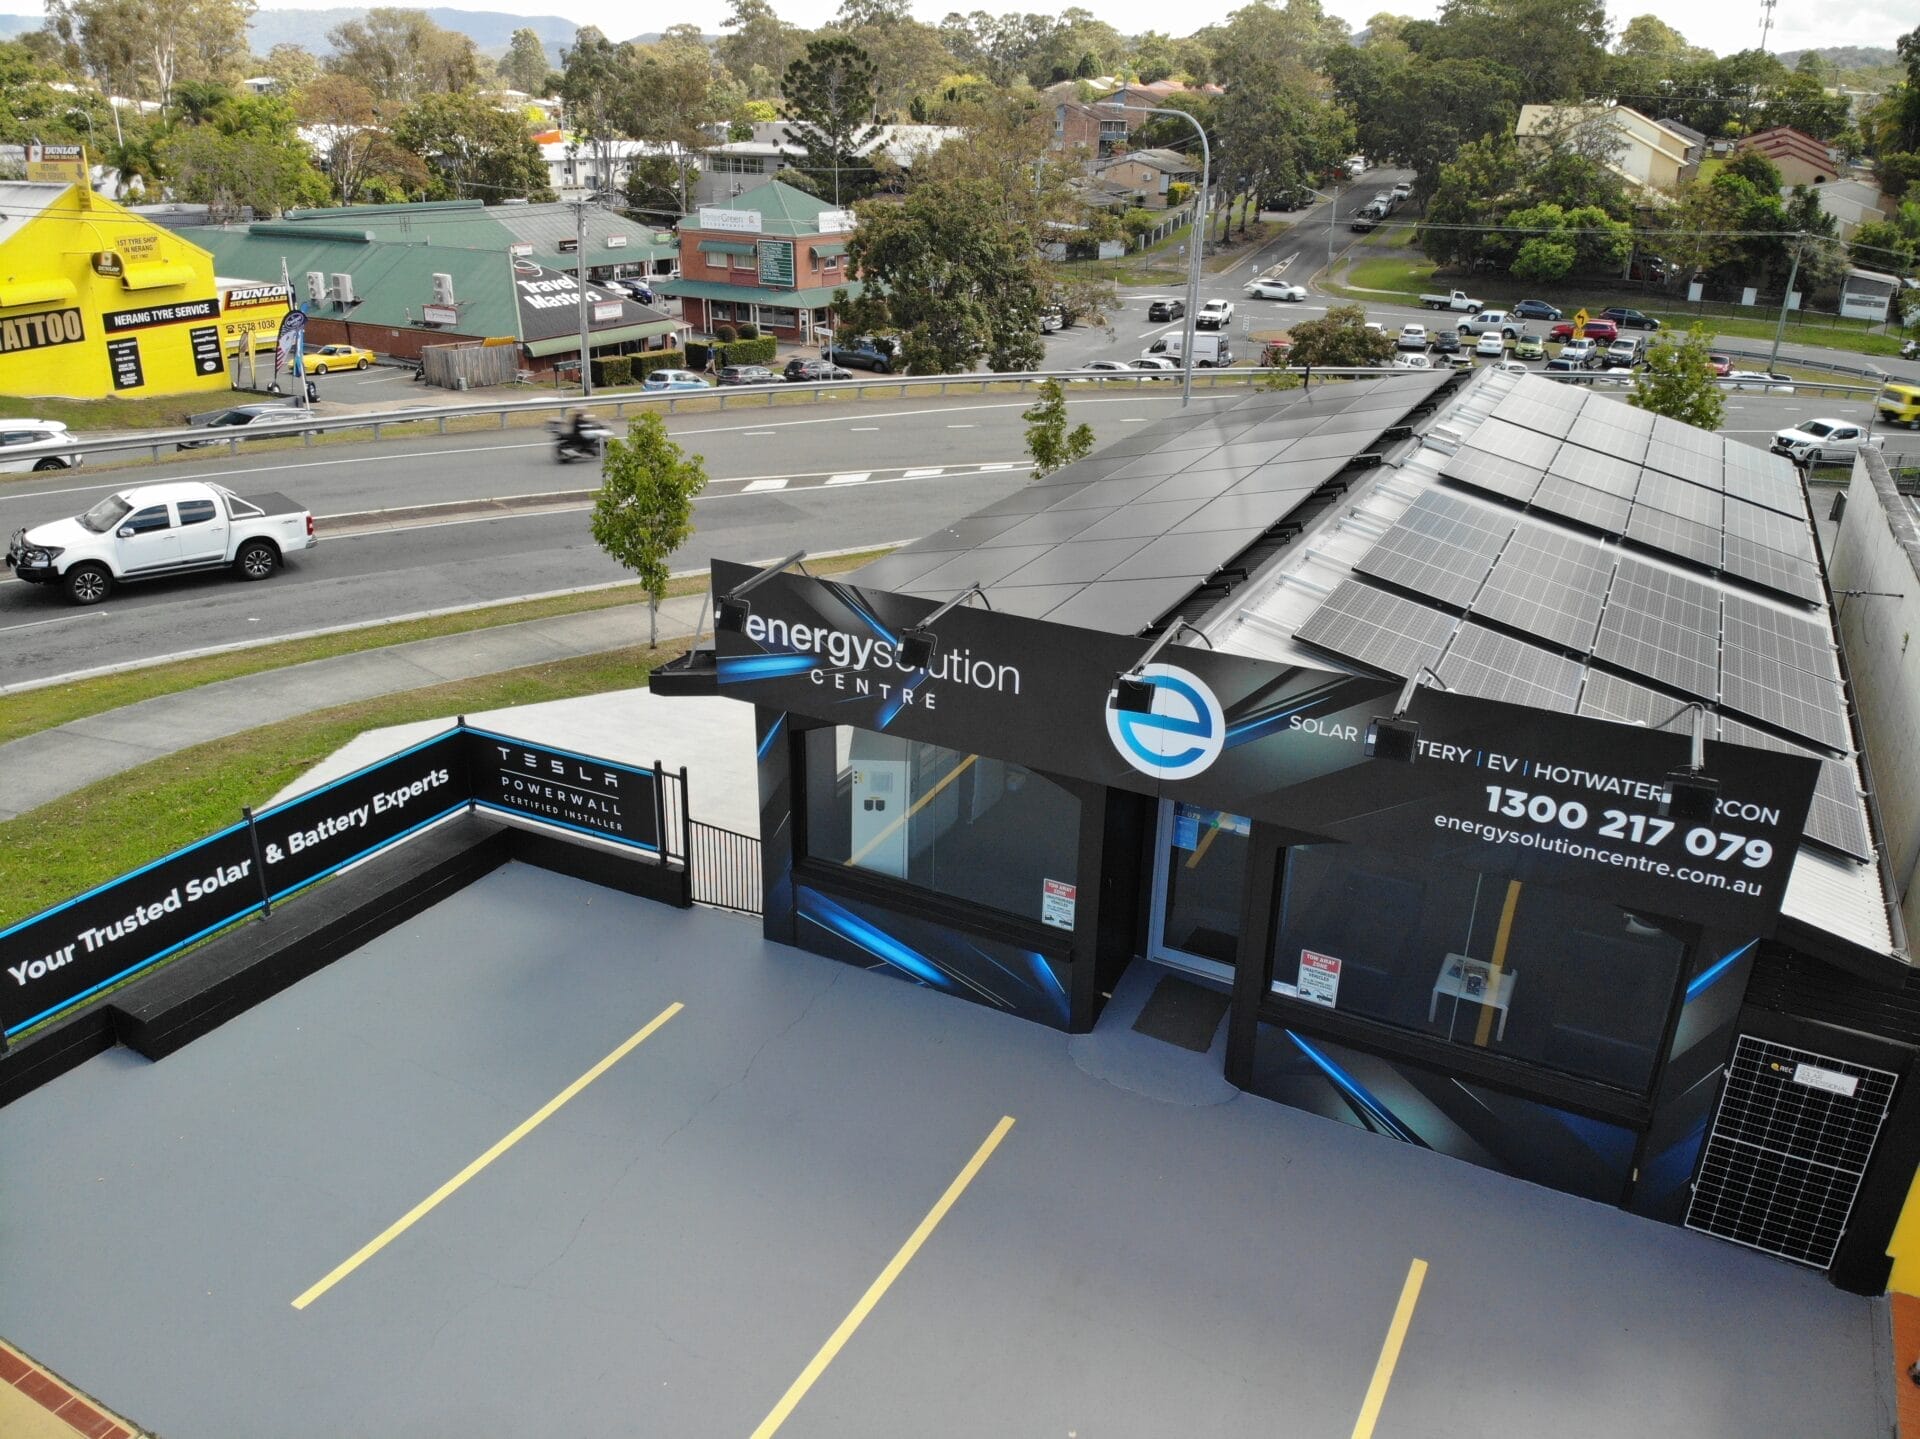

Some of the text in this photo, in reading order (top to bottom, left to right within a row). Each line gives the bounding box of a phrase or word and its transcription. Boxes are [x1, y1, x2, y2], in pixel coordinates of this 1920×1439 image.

[45, 146, 80, 155] DUNLOP
[131, 244, 154, 253] NERANG
[143, 236, 158, 244] SHOP
[516, 275, 578, 293] Travel
[523, 290, 602, 309] Masters
[114, 303, 210, 327] NERANG TYRE SERVICE
[258, 320, 275, 330] 1038
[0, 310, 82, 351] ATTOO
[811, 668, 936, 710] CENTRE
[497, 747, 618, 788] TESLA
[1289, 715, 1358, 742] SOLAR
[1487, 753, 1519, 773] EV
[1534, 762, 1664, 802] HOTWATER
[501, 776, 621, 816] POWERWALL
[504, 794, 623, 831] CERTIFIED INSTALLER
[1486, 785, 1774, 869] 1300 217 079
[1434, 814, 1763, 897] energysolutioncentre.com.au
[8, 769, 449, 986] Your Trusted Solar & Battery Experts
[1306, 953, 1336, 965] TOW AWAY
[1312, 961, 1328, 969] ZONE
